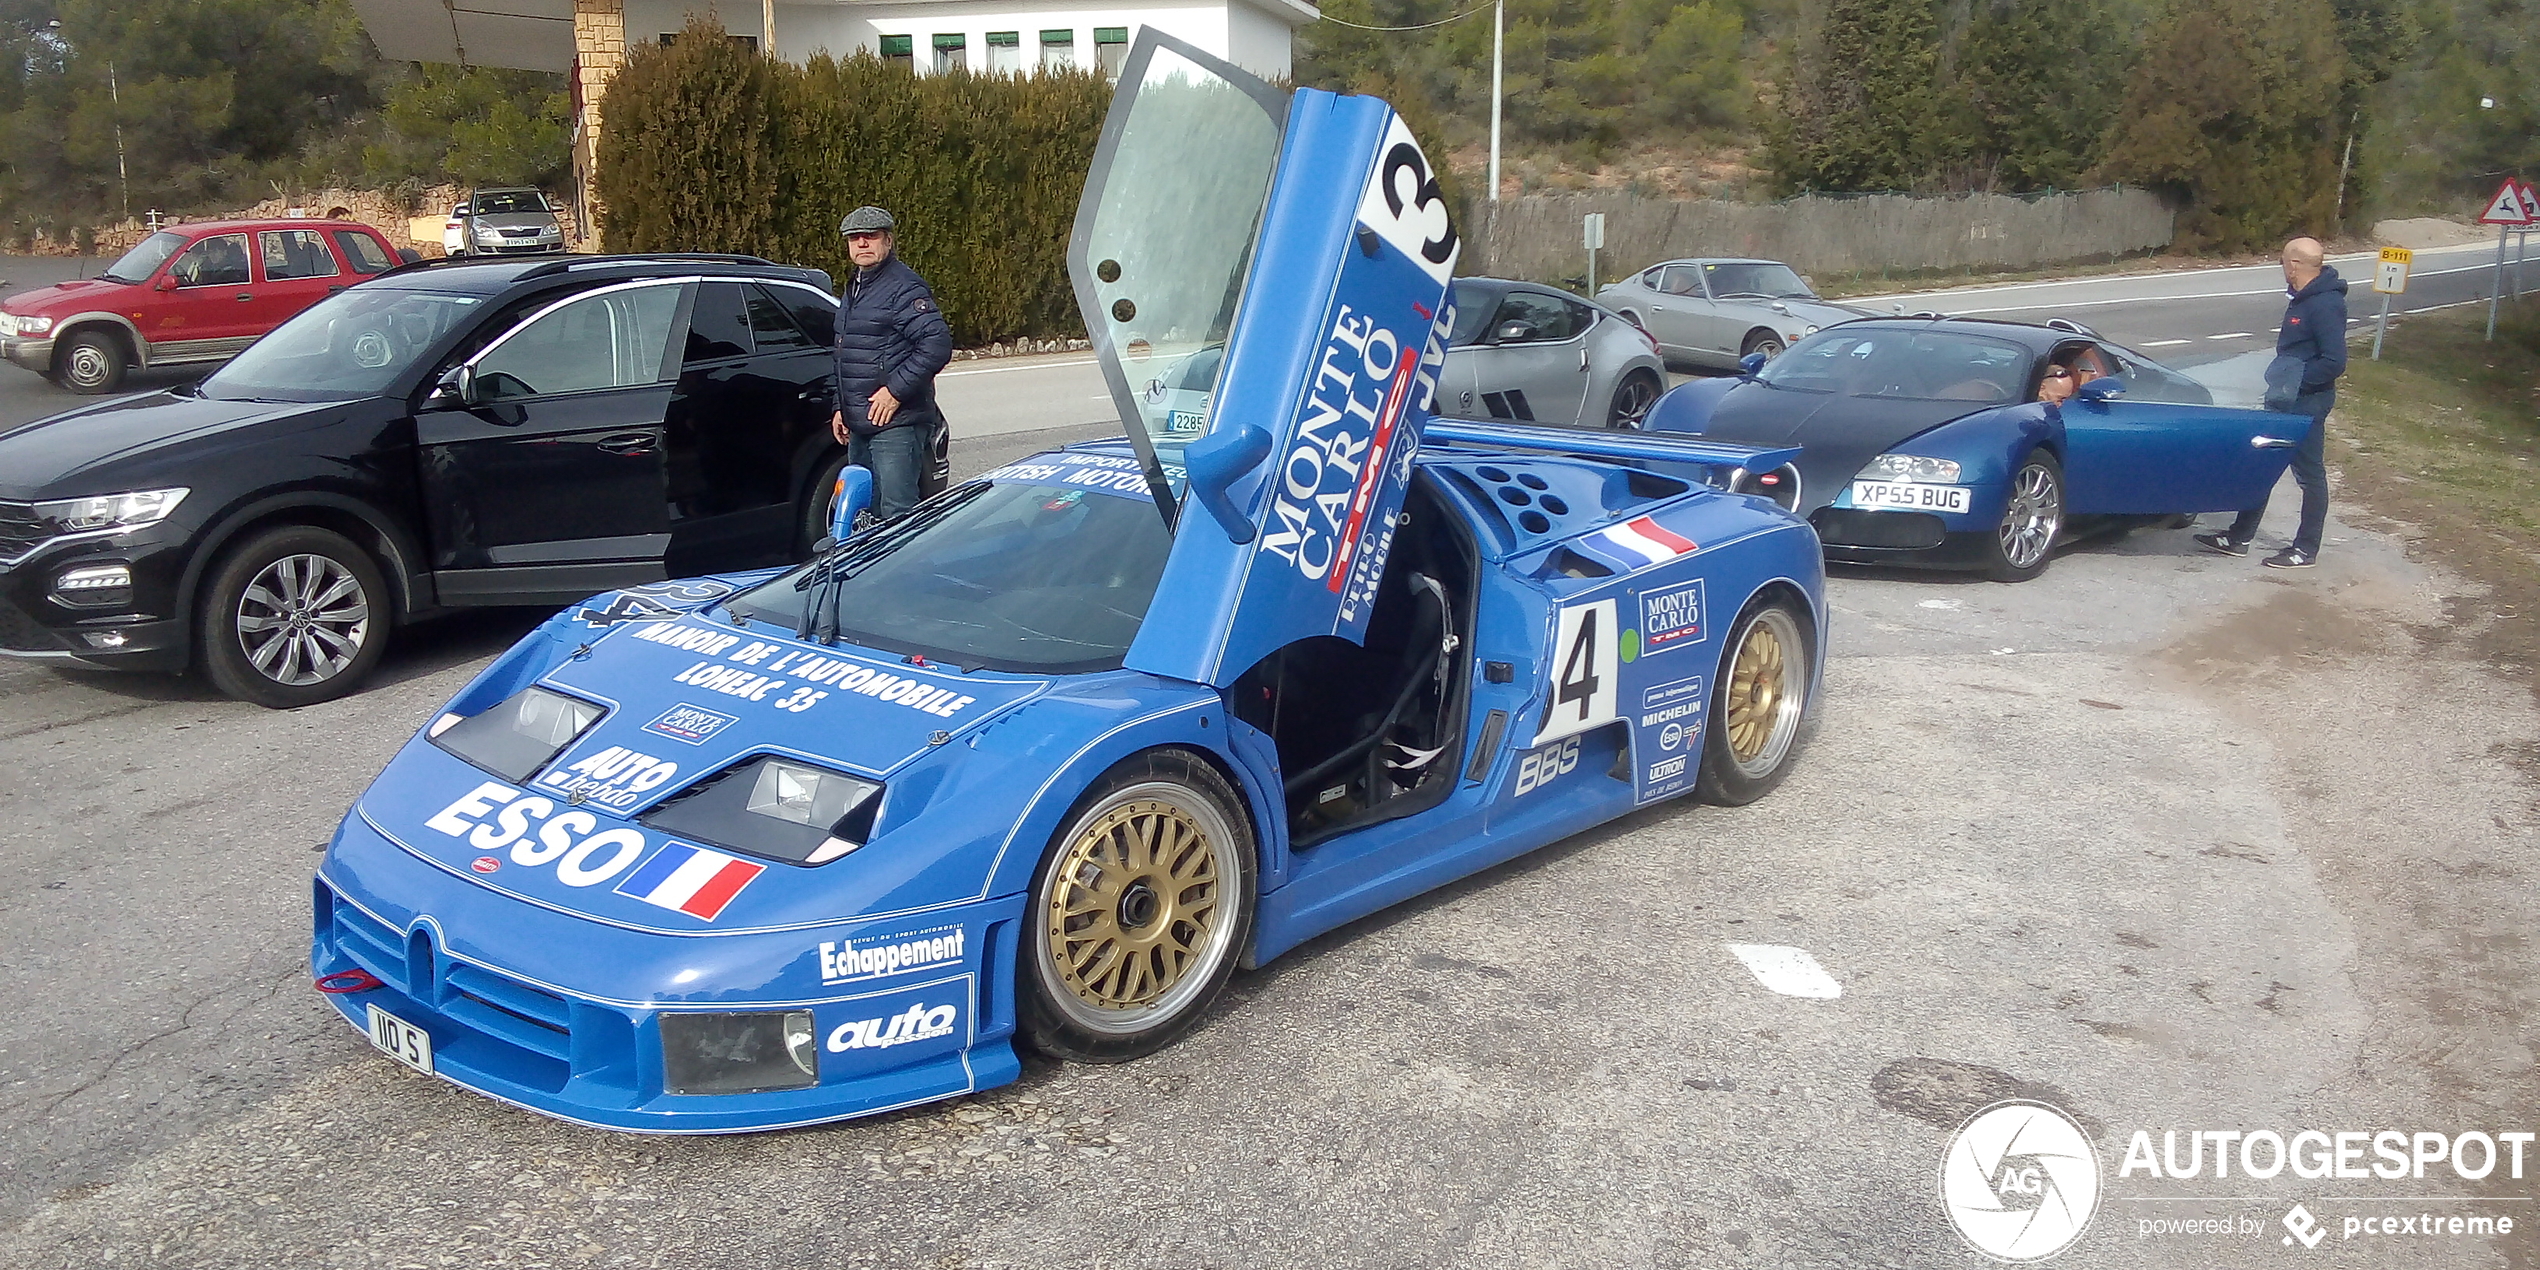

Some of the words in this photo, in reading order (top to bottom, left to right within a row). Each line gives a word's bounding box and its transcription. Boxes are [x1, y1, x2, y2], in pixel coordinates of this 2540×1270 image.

[1382, 142, 1460, 264] 3
[2382, 250, 2408, 261] B-111
[2387, 276, 2393, 288] 1
[1414, 301, 1458, 412] JVC
[1260, 304, 1373, 567] MONTE
[1298, 328, 1398, 580] CARLO
[1333, 368, 1407, 577] TMC
[1861, 485, 1915, 505] XP55
[1922, 488, 1961, 508] BUG
[1341, 533, 1376, 622] RETRO
[1362, 507, 1399, 608] MOBILE
[1647, 589, 1698, 616] MONTE
[1648, 606, 1699, 633] CARLO
[1651, 627, 1696, 642] TMC
[631, 622, 741, 656] MANOIR
[728, 642, 782, 666] DE
[767, 651, 976, 718] L'AUTOMOBILE
[673, 662, 787, 701] LOHEAC
[774, 687, 830, 713] 35
[1558, 608, 1599, 722] 4
[662, 716, 714, 734] CARLO
[673, 708, 726, 727] MONTE
[1642, 701, 1701, 727] MICHELIN
[558, 771, 638, 806] hebdo
[567, 746, 678, 793] AUTO
[1514, 735, 1582, 797] BBS
[1649, 758, 1686, 780] ULTRON
[424, 780, 646, 888] ESSO
[819, 929, 965, 979] Echappement
[853, 936, 875, 944] REVUE
[895, 930, 917, 938] SPORT
[919, 922, 964, 934] AUTOMOBILE
[377, 1013, 400, 1053] 110
[406, 1029, 420, 1064] S
[827, 1002, 957, 1052] auto
[881, 1026, 954, 1049] passion
